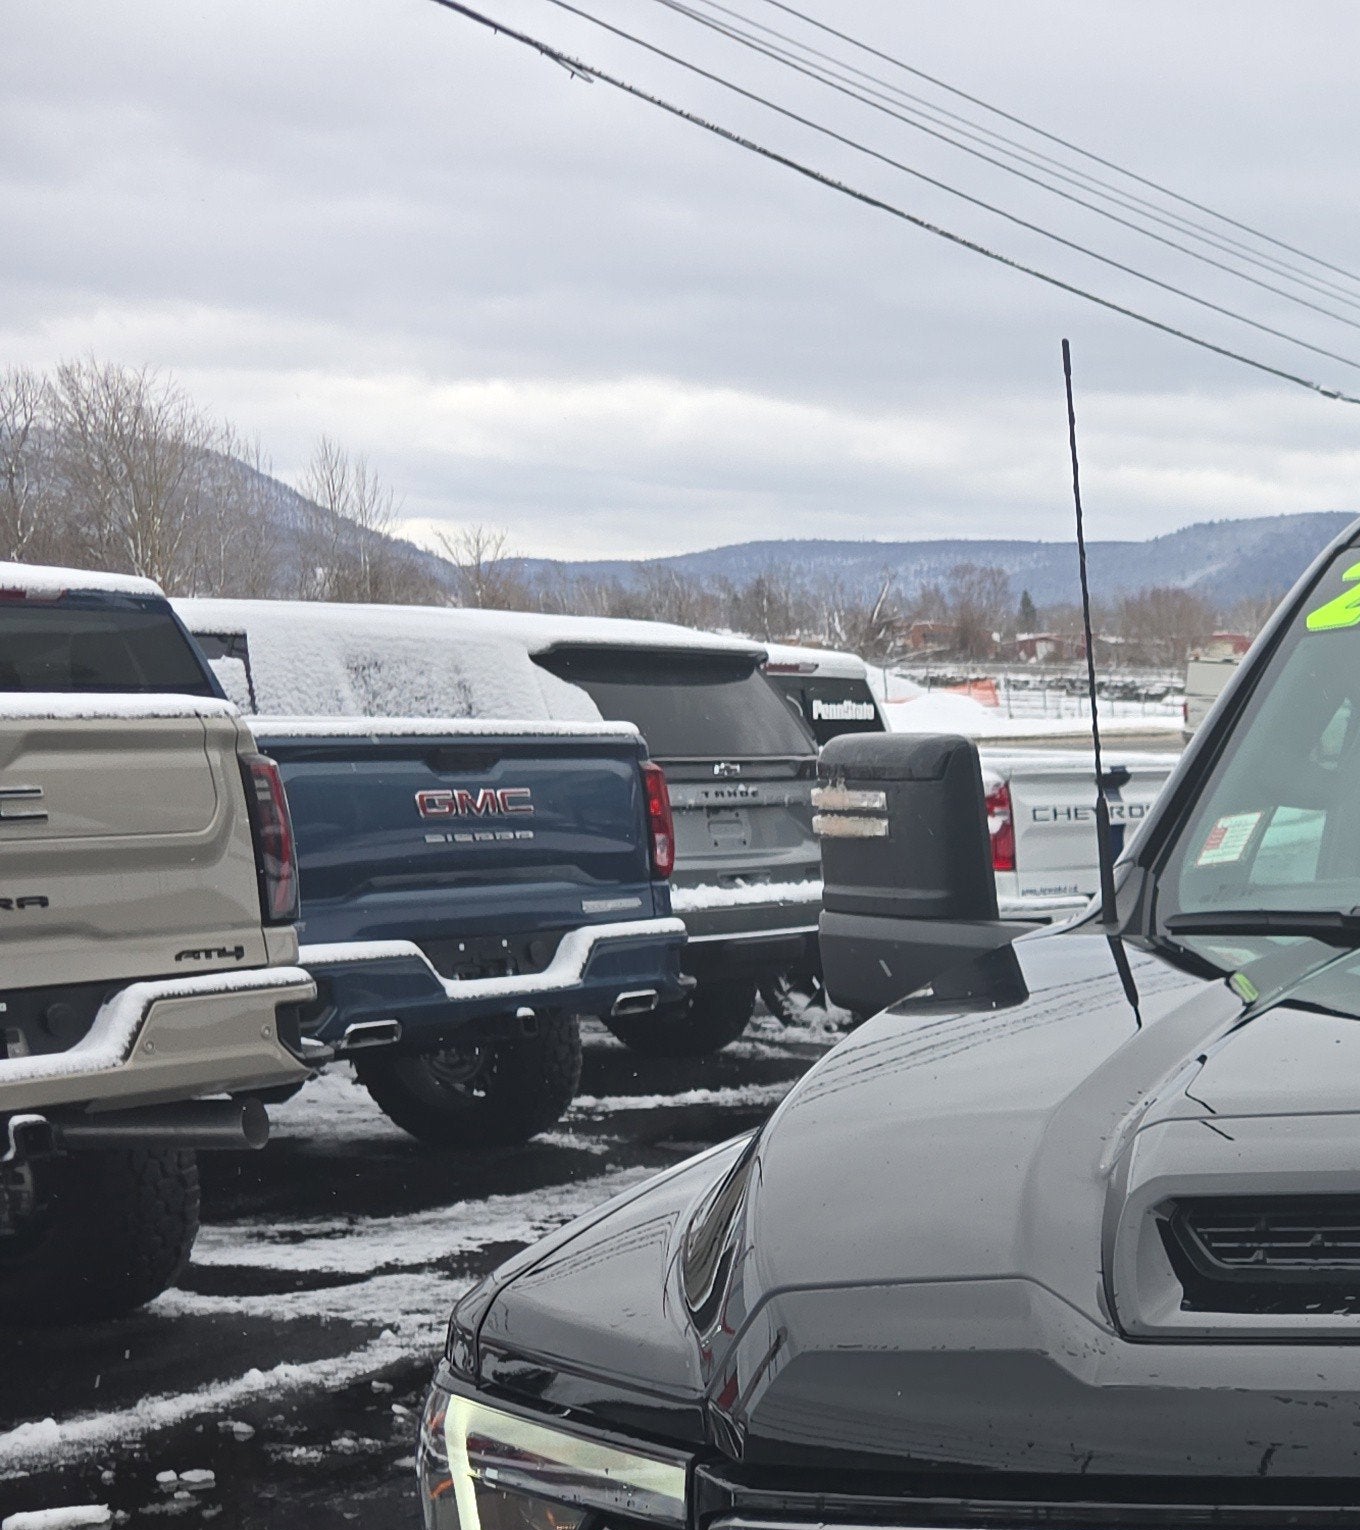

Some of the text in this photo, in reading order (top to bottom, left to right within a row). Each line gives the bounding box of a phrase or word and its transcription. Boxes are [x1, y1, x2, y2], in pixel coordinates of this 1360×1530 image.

[415, 788, 534, 818] GMC
[1032, 804, 1151, 822] CHERO
[175, 946, 245, 961] AT4
